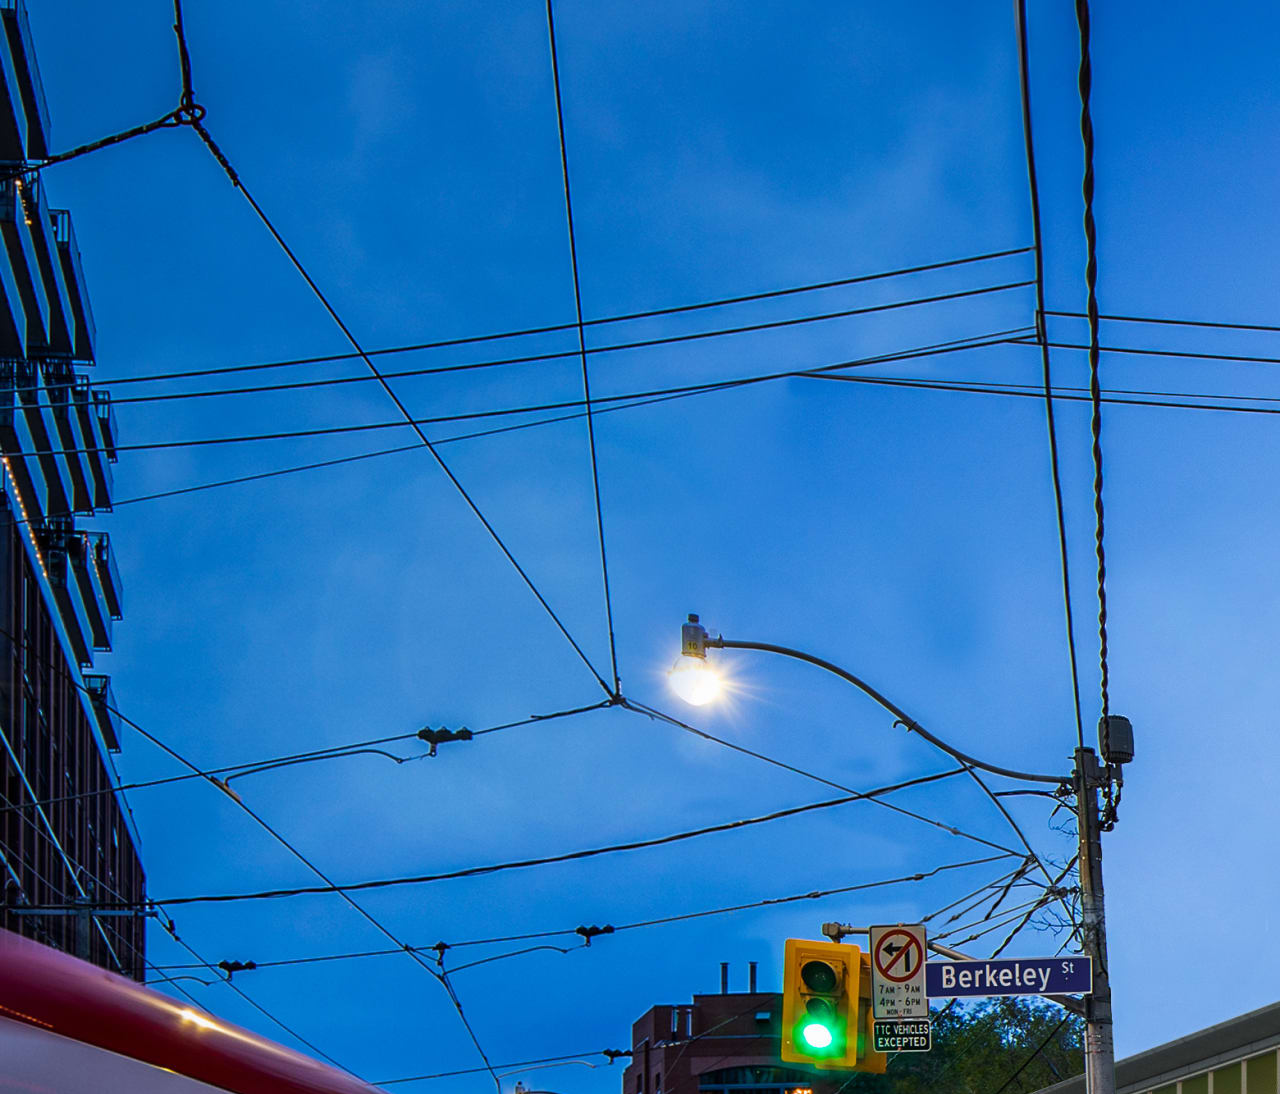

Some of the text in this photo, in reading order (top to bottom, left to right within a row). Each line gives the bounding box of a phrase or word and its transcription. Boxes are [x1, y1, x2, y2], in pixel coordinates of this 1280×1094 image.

[941, 961, 1075, 992] Berkeley St
[879, 984, 895, 994] 7AM
[904, 983, 921, 993] 9AM
[879, 997, 896, 1006] 4PM
[905, 996, 921, 1006] 6PM
[875, 1024, 929, 1035] TTC VEHICLES
[878, 1036, 927, 1047] EXCEPTED
